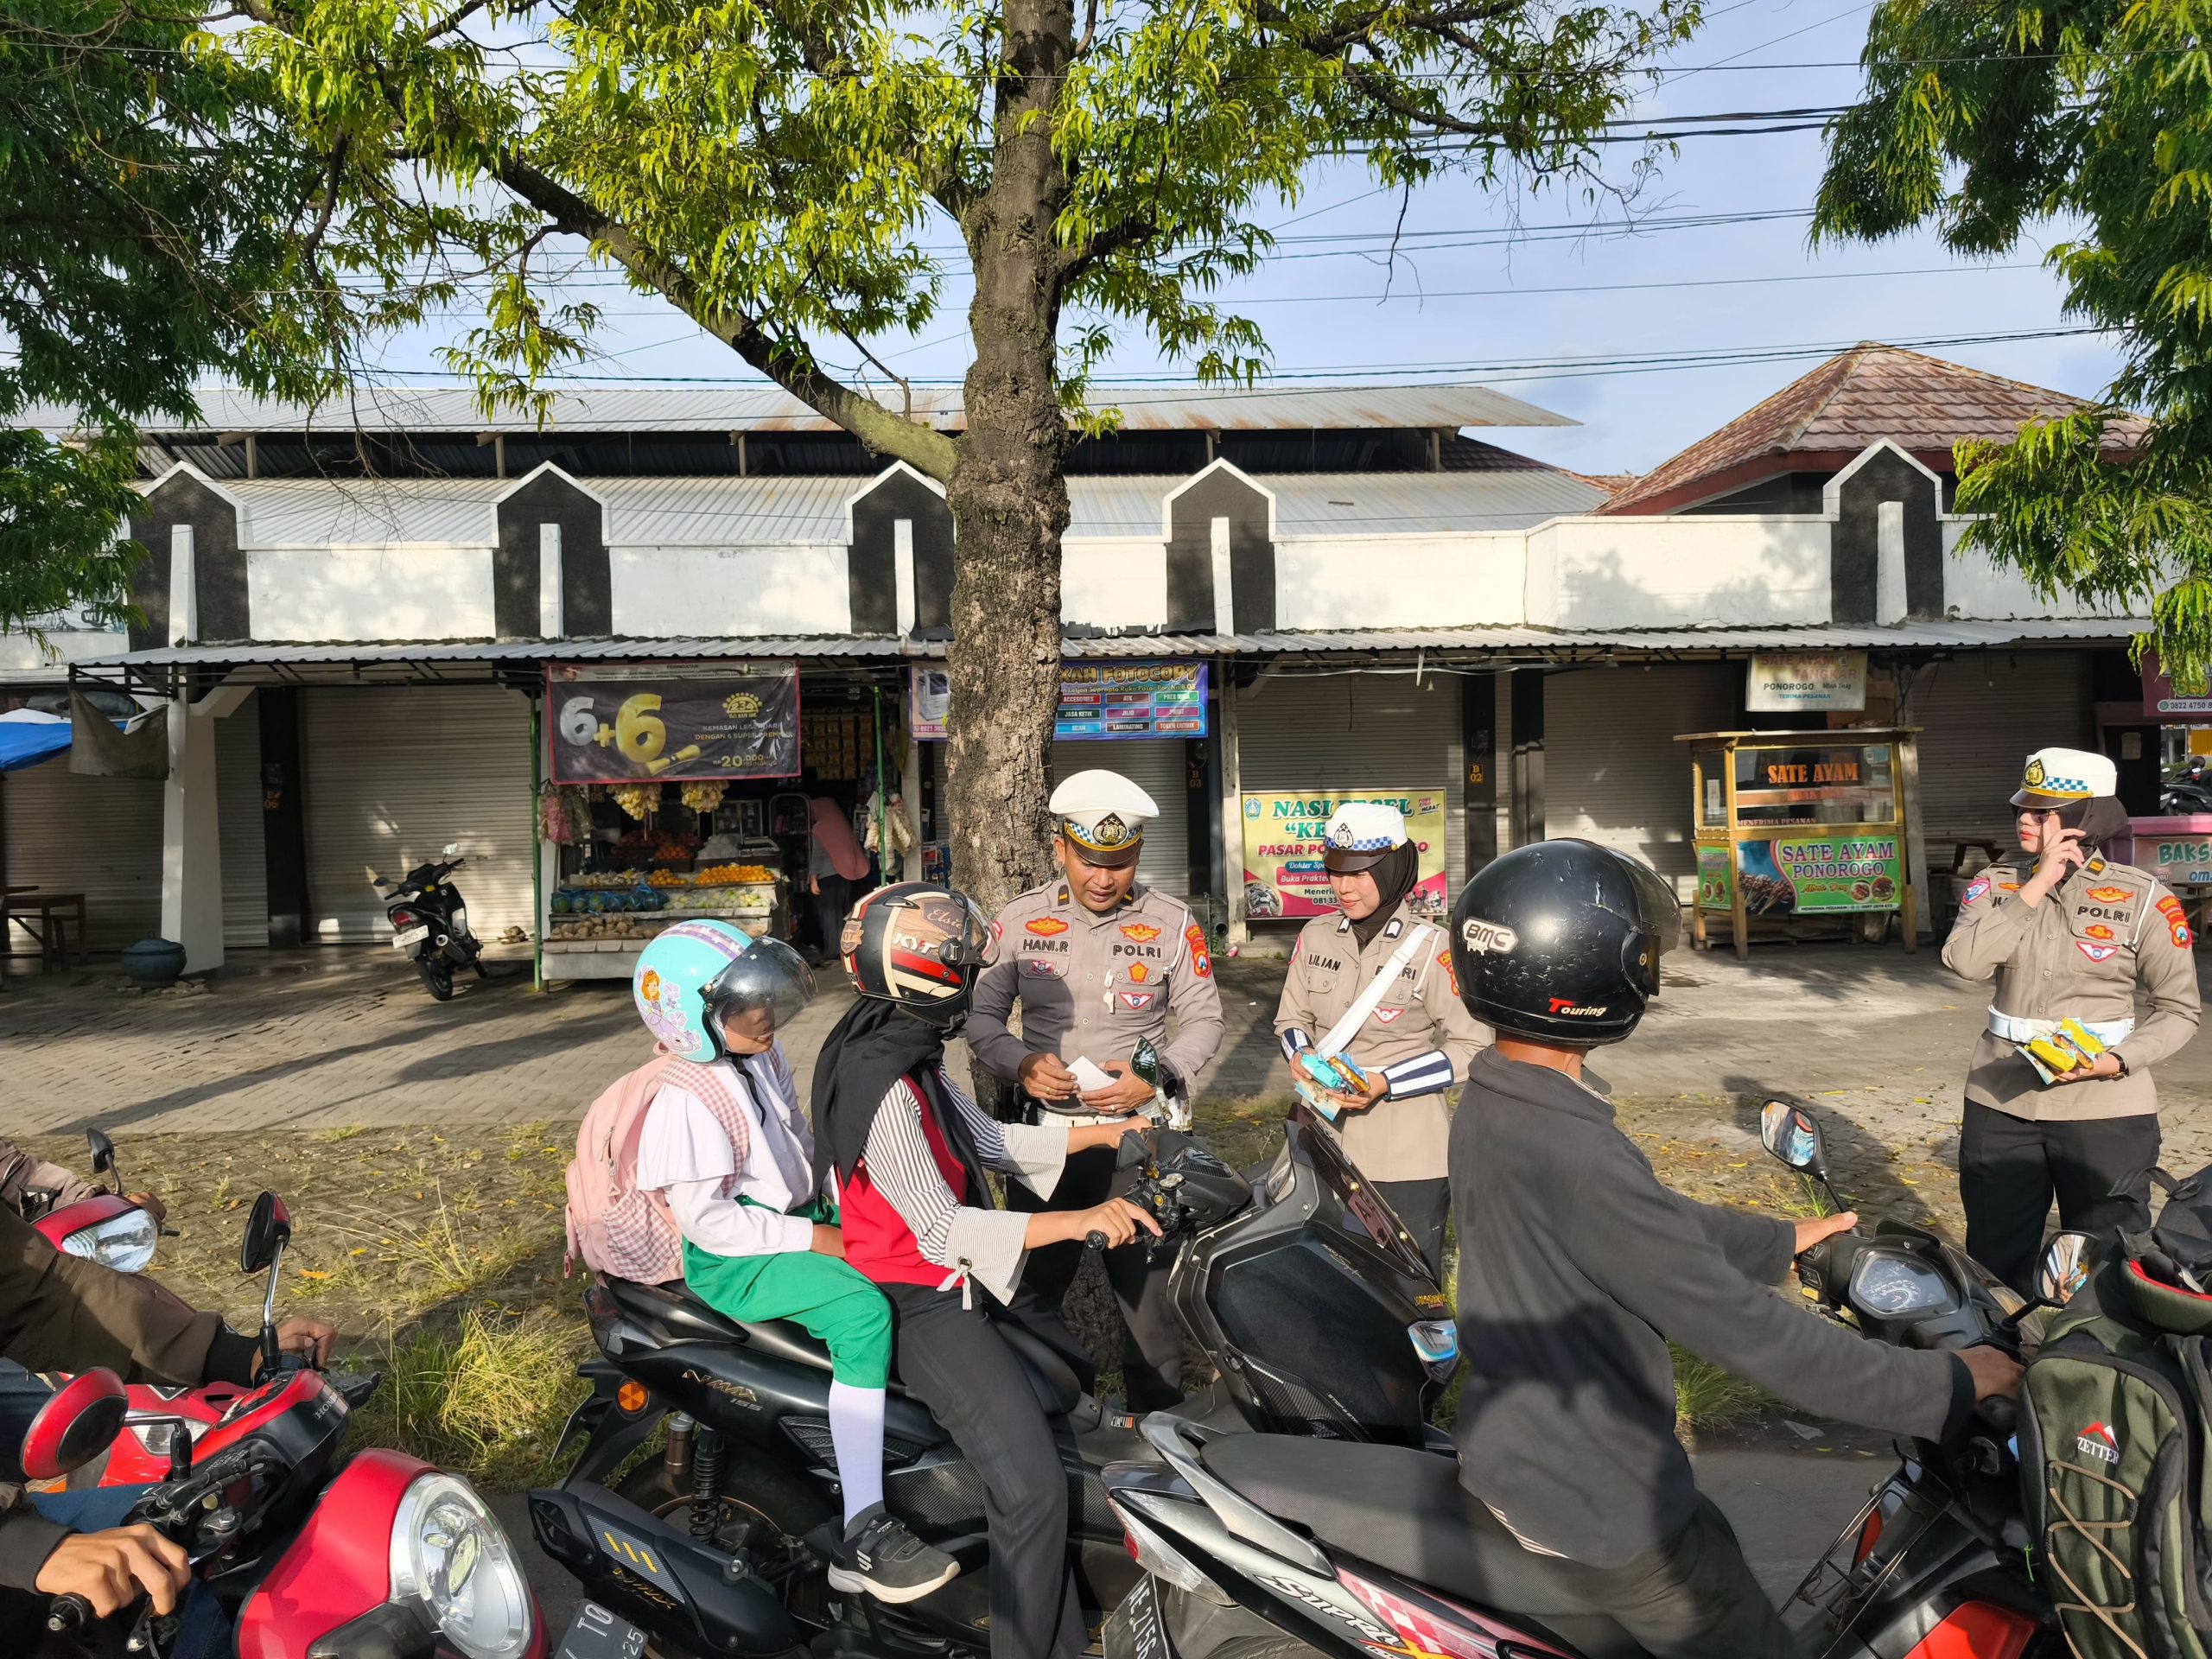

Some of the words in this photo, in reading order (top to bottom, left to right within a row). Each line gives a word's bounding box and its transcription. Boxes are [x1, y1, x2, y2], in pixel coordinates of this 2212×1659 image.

[1761, 655, 1794, 665] SATE
[1798, 655, 1834, 665] AYAM
[1060, 665, 1098, 683] KAH
[1101, 662, 1200, 684] FOTOCOPY
[731, 701, 754, 710] 234
[1470, 773, 1483, 782] 02
[1768, 765, 1808, 784] SATE
[1813, 763, 1859, 782] AYAM
[1273, 798, 1332, 818] NASI
[1738, 818, 1780, 827] MENERIMA
[1258, 844, 1305, 857] PASAR
[1783, 843, 1833, 863] SATE
[1839, 841, 1895, 861] AYAM
[2158, 842, 2212, 867] BAKS
[1791, 861, 1885, 880] PONOROGO
[2076, 906, 2131, 924] POLRI
[1466, 924, 1511, 948] BMC
[1022, 938, 1069, 953] HANI.R
[1113, 944, 1161, 958] POLRI
[1308, 953, 1342, 971] LILIAN
[1375, 964, 1417, 981] PRI
[1548, 997, 1607, 1017] Touring
[2076, 1435, 2120, 1465] ZETTER
[1255, 1575, 1402, 1647] Supra
